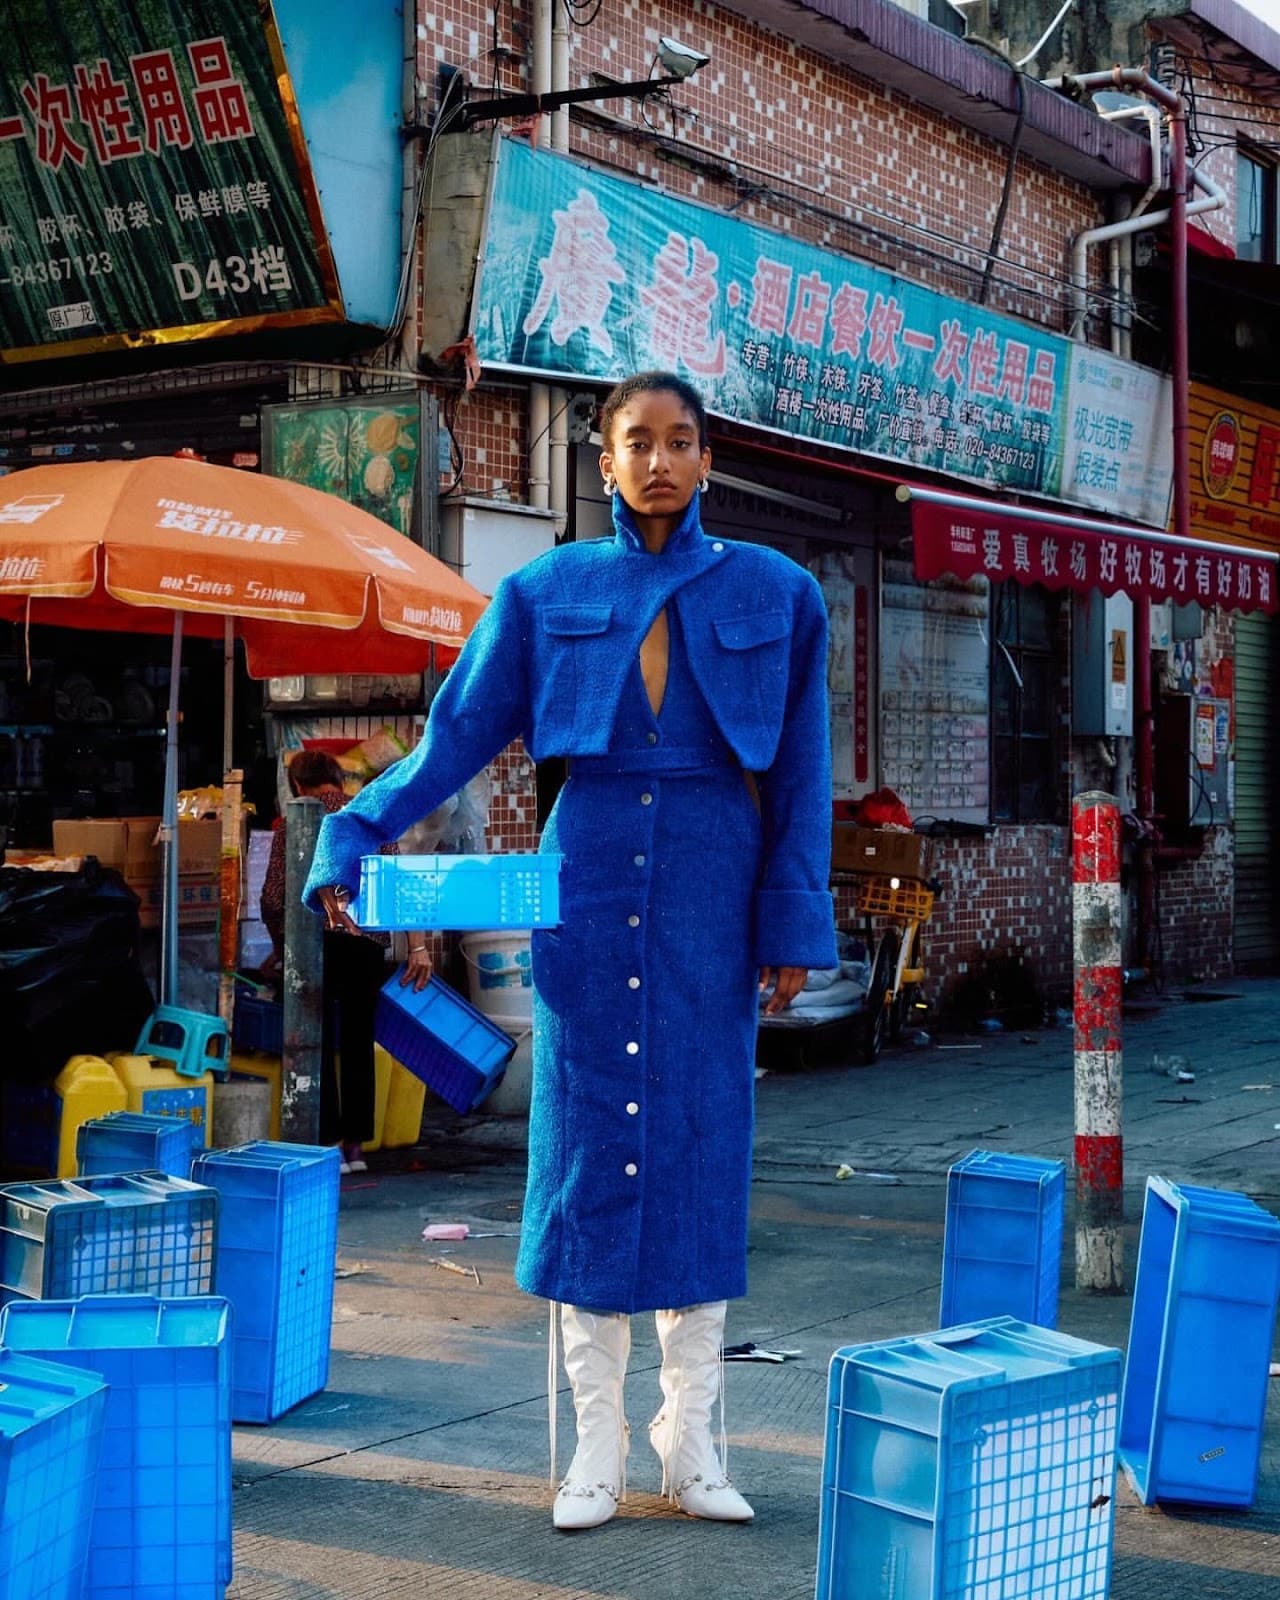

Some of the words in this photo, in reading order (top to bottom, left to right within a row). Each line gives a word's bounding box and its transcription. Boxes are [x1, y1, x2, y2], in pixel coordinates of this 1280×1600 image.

[172, 245, 292, 301] D43档
[1074, 406, 1134, 452] 极光宽带
[1074, 449, 1121, 493] 报装点
